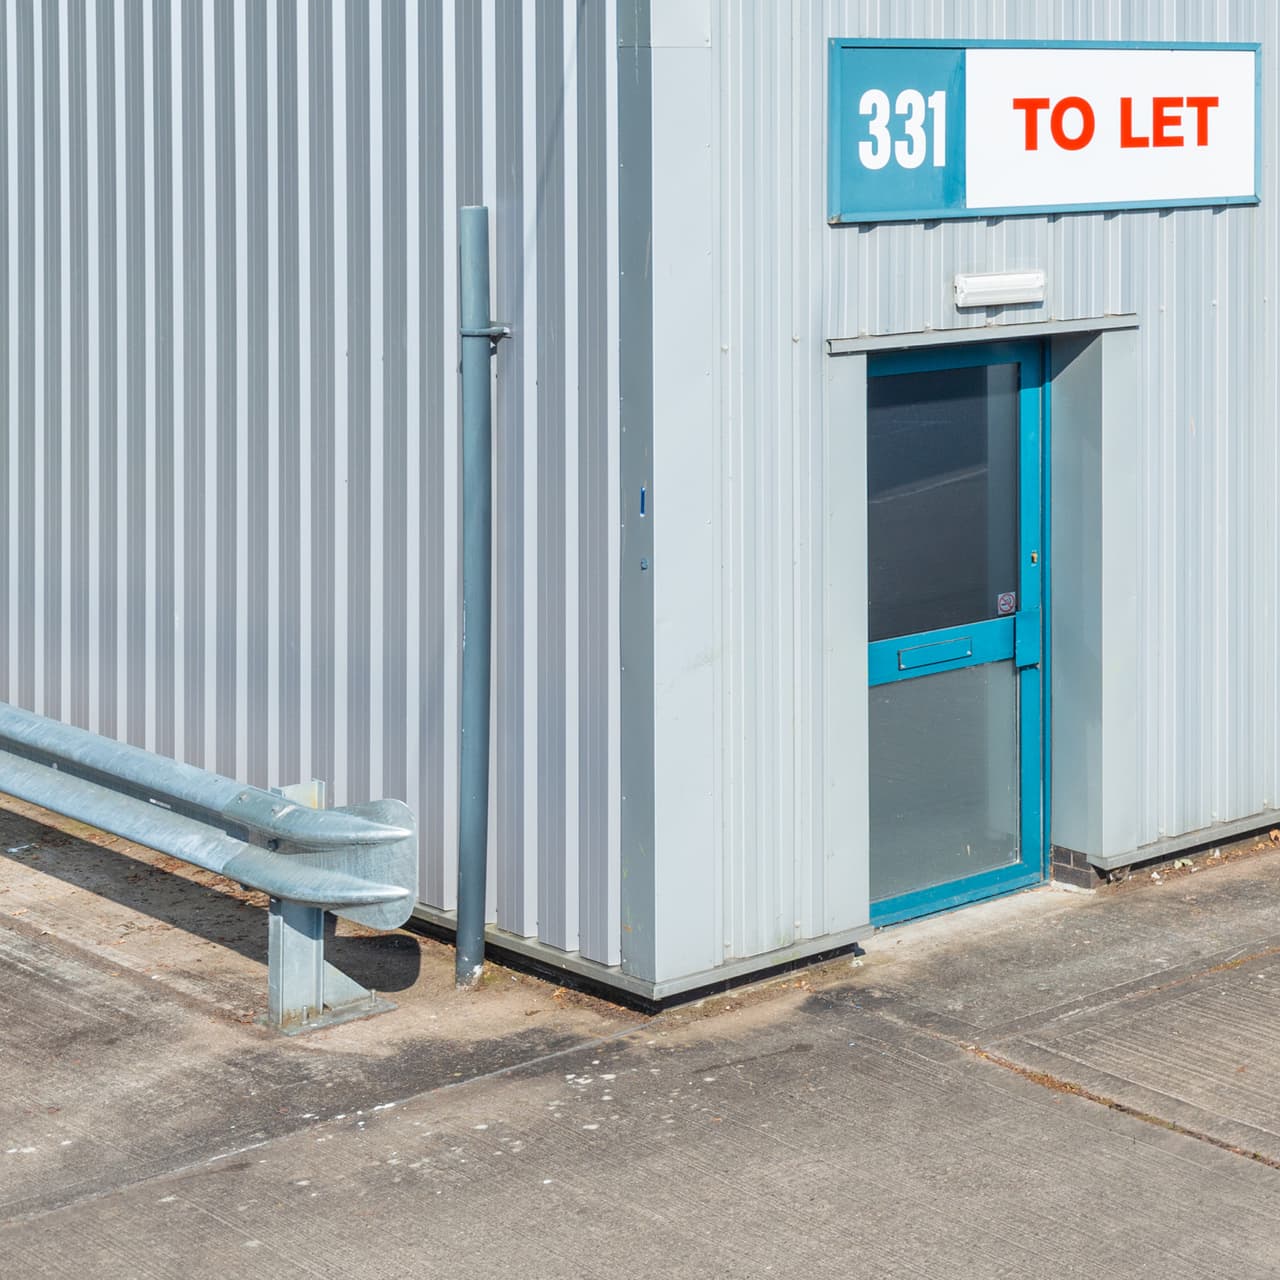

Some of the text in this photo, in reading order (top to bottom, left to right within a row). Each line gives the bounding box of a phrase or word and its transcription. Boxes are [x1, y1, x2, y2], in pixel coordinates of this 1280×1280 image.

[858, 89, 946, 170] 331
[1012, 96, 1219, 151] TO LET
